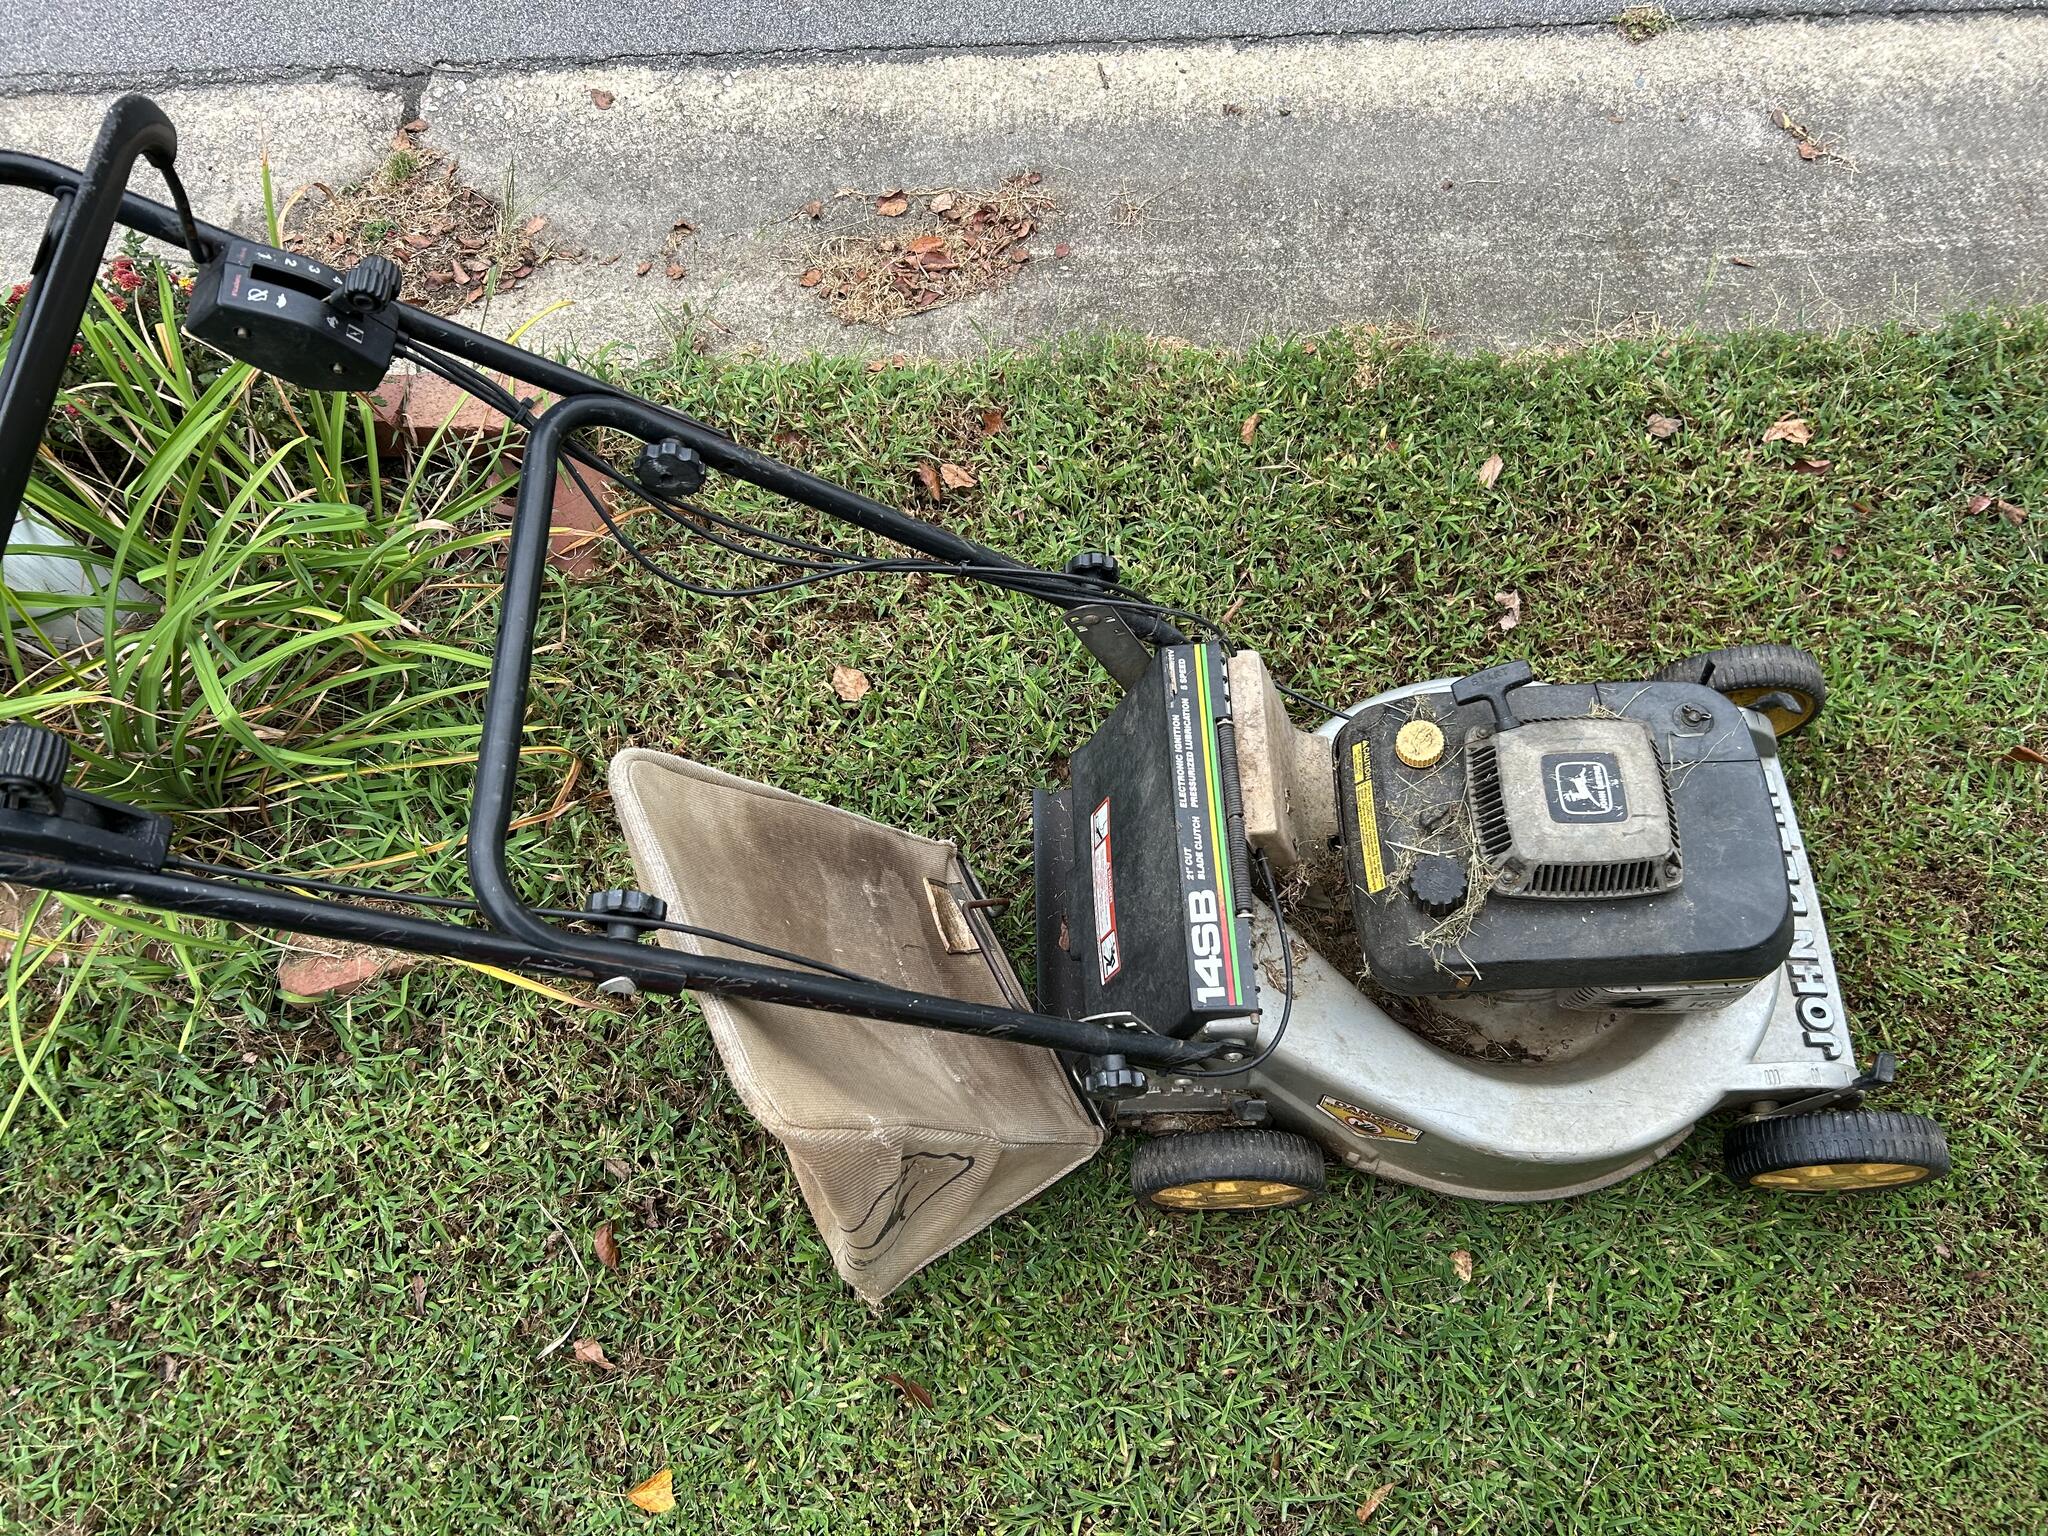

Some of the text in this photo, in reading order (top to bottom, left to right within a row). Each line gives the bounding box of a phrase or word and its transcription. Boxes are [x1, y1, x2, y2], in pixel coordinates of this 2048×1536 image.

[257, 251, 272, 260] 1
[284, 257, 297, 267] 2
[308, 264, 320, 274] 3
[332, 275, 343, 285] 4
[1178, 658, 1188, 684] SPEED
[1171, 714, 1183, 753] IGNITION
[1181, 698, 1199, 808] PRESSURIZED LUBRICATION
[1363, 746, 1372, 780] CAUTION
[1175, 754, 1187, 808] ELECTRONIC
[1598, 791, 1609, 811] JOHN
[1184, 846, 1193, 866] CUT
[1191, 816, 1206, 880] BLADE CLUTCH
[1188, 889, 1226, 1004] 14SB
[1786, 929, 1843, 1061] JOHN
[1334, 1100, 1409, 1132] DANGER
